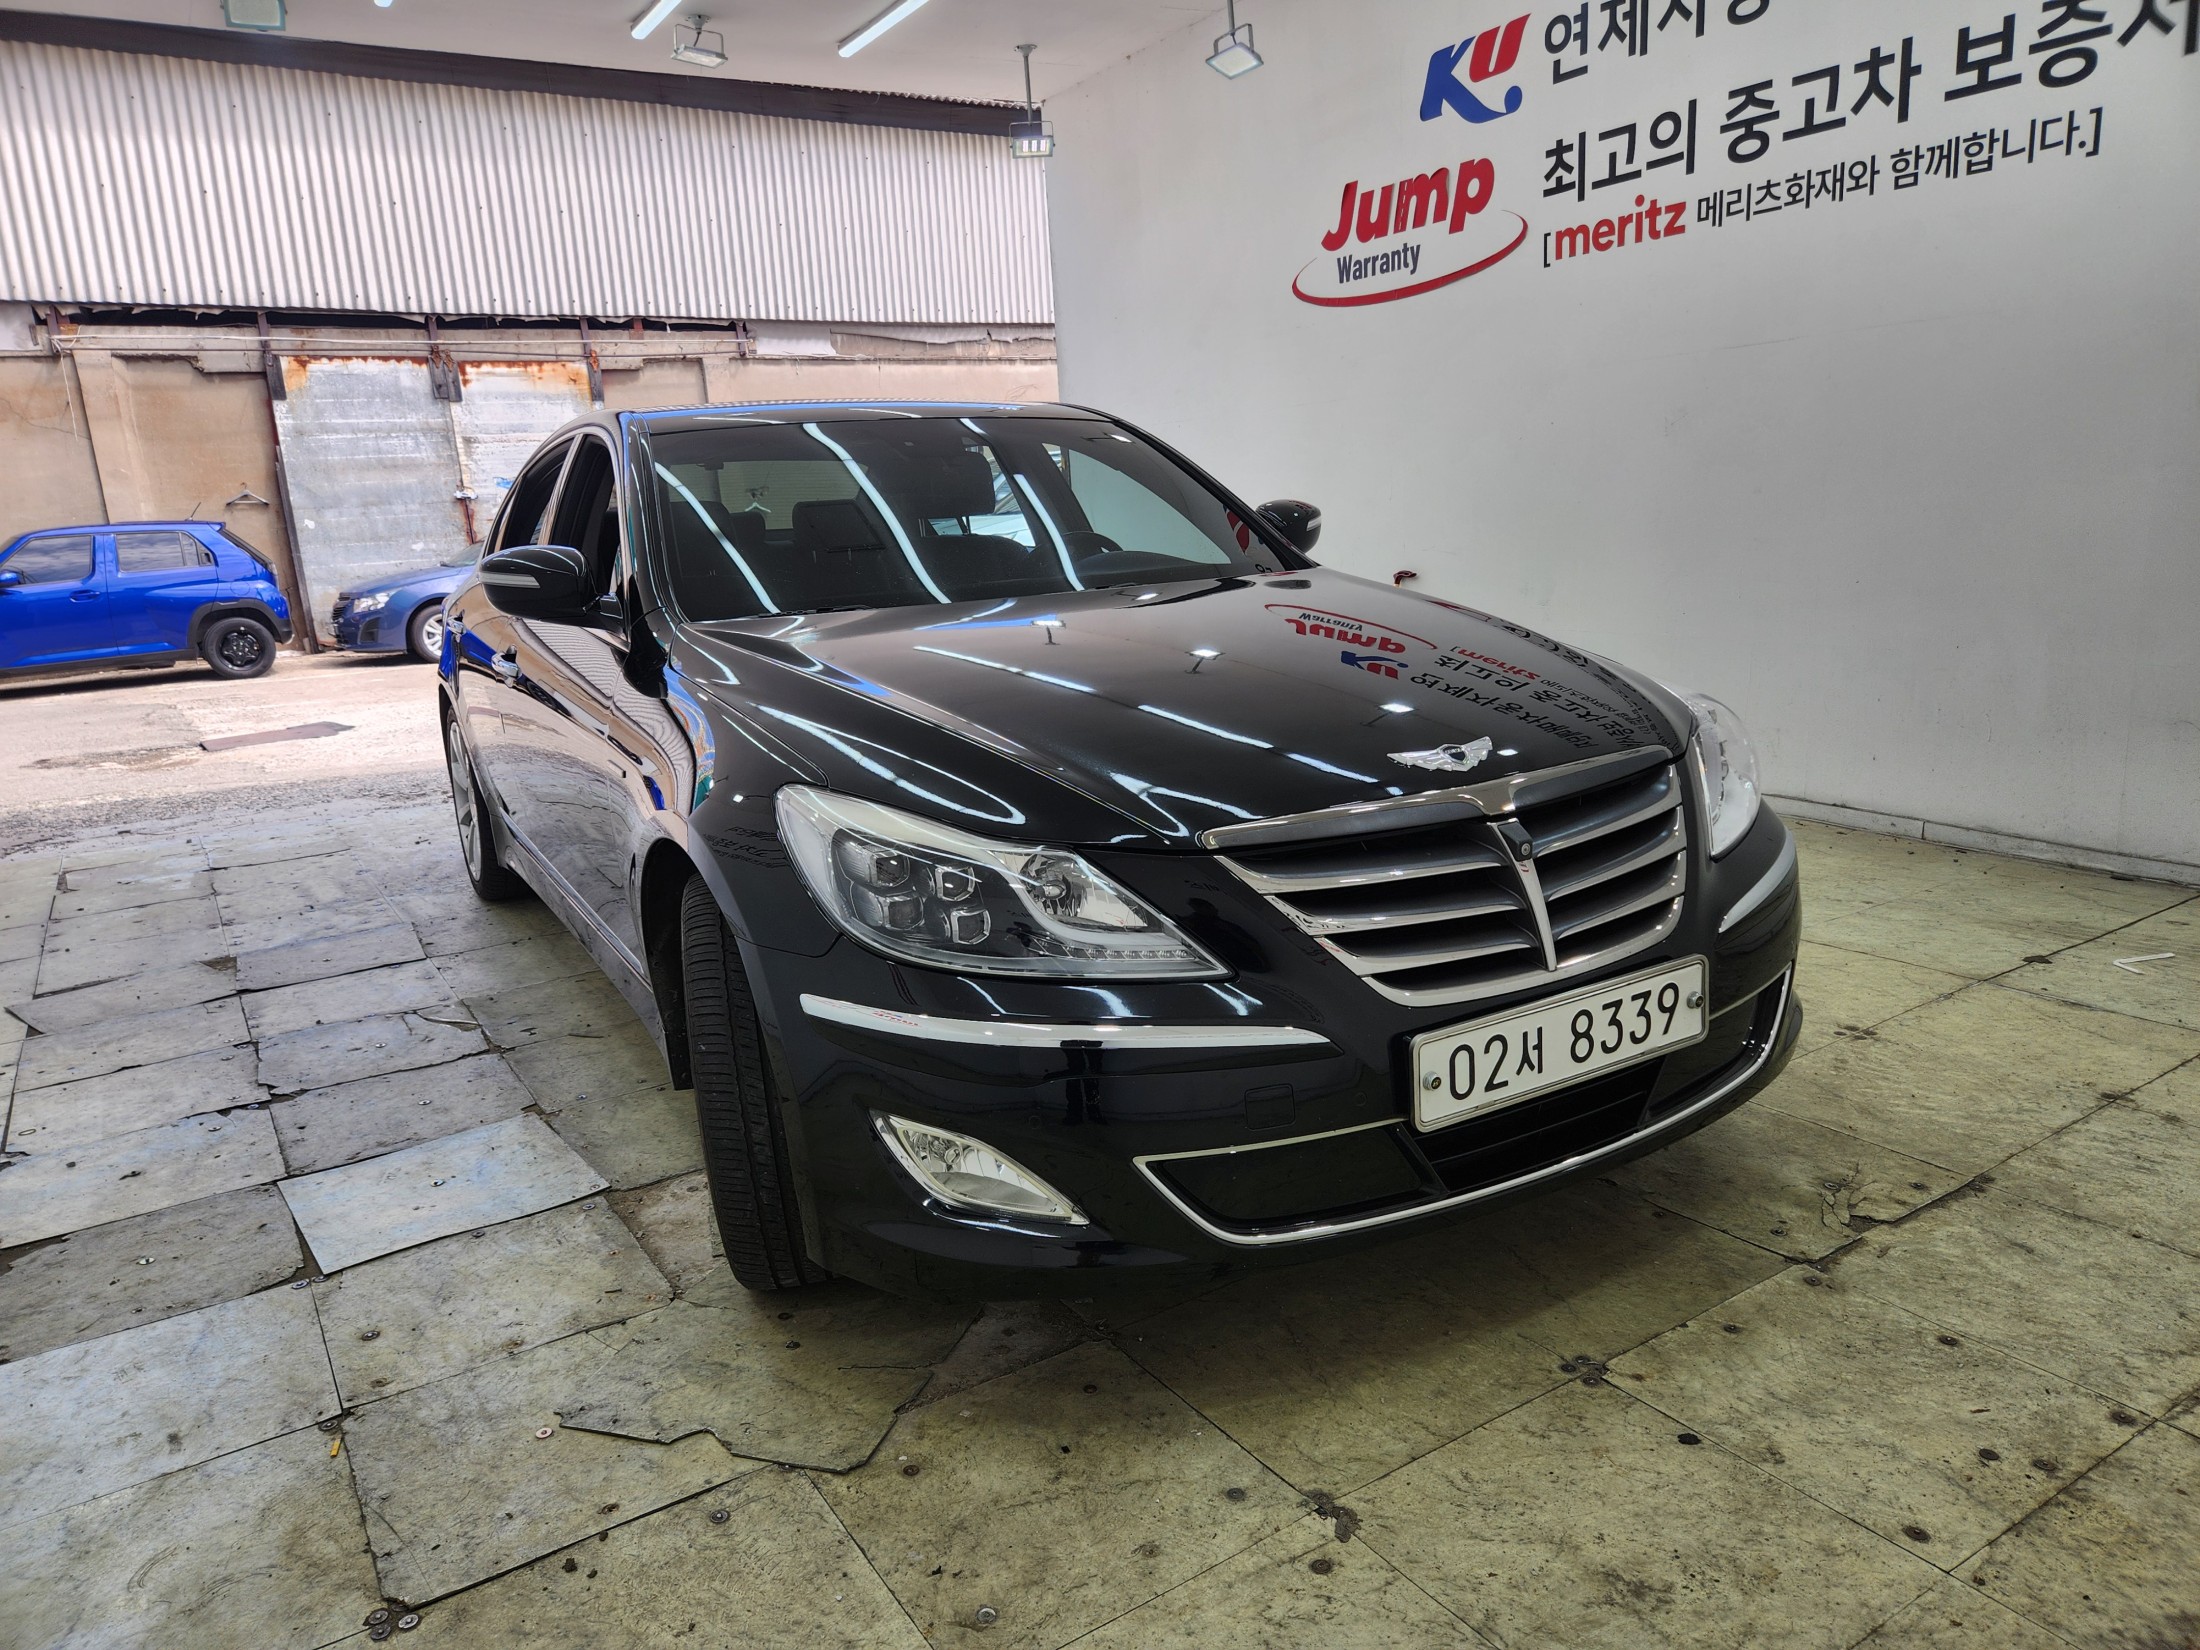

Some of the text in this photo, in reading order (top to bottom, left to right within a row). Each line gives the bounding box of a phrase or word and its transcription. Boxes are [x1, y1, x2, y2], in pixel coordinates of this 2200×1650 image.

[1543, 99, 1698, 199] 최고의
[1720, 37, 1923, 163] 중고차
[1321, 157, 1495, 252] Jump
[1544, 106, 2103, 269] [meritz 메리츠화재와 함께합니다.]
[1336, 243, 1421, 284] Warranty
[1449, 982, 1680, 1101] 02서 8339
